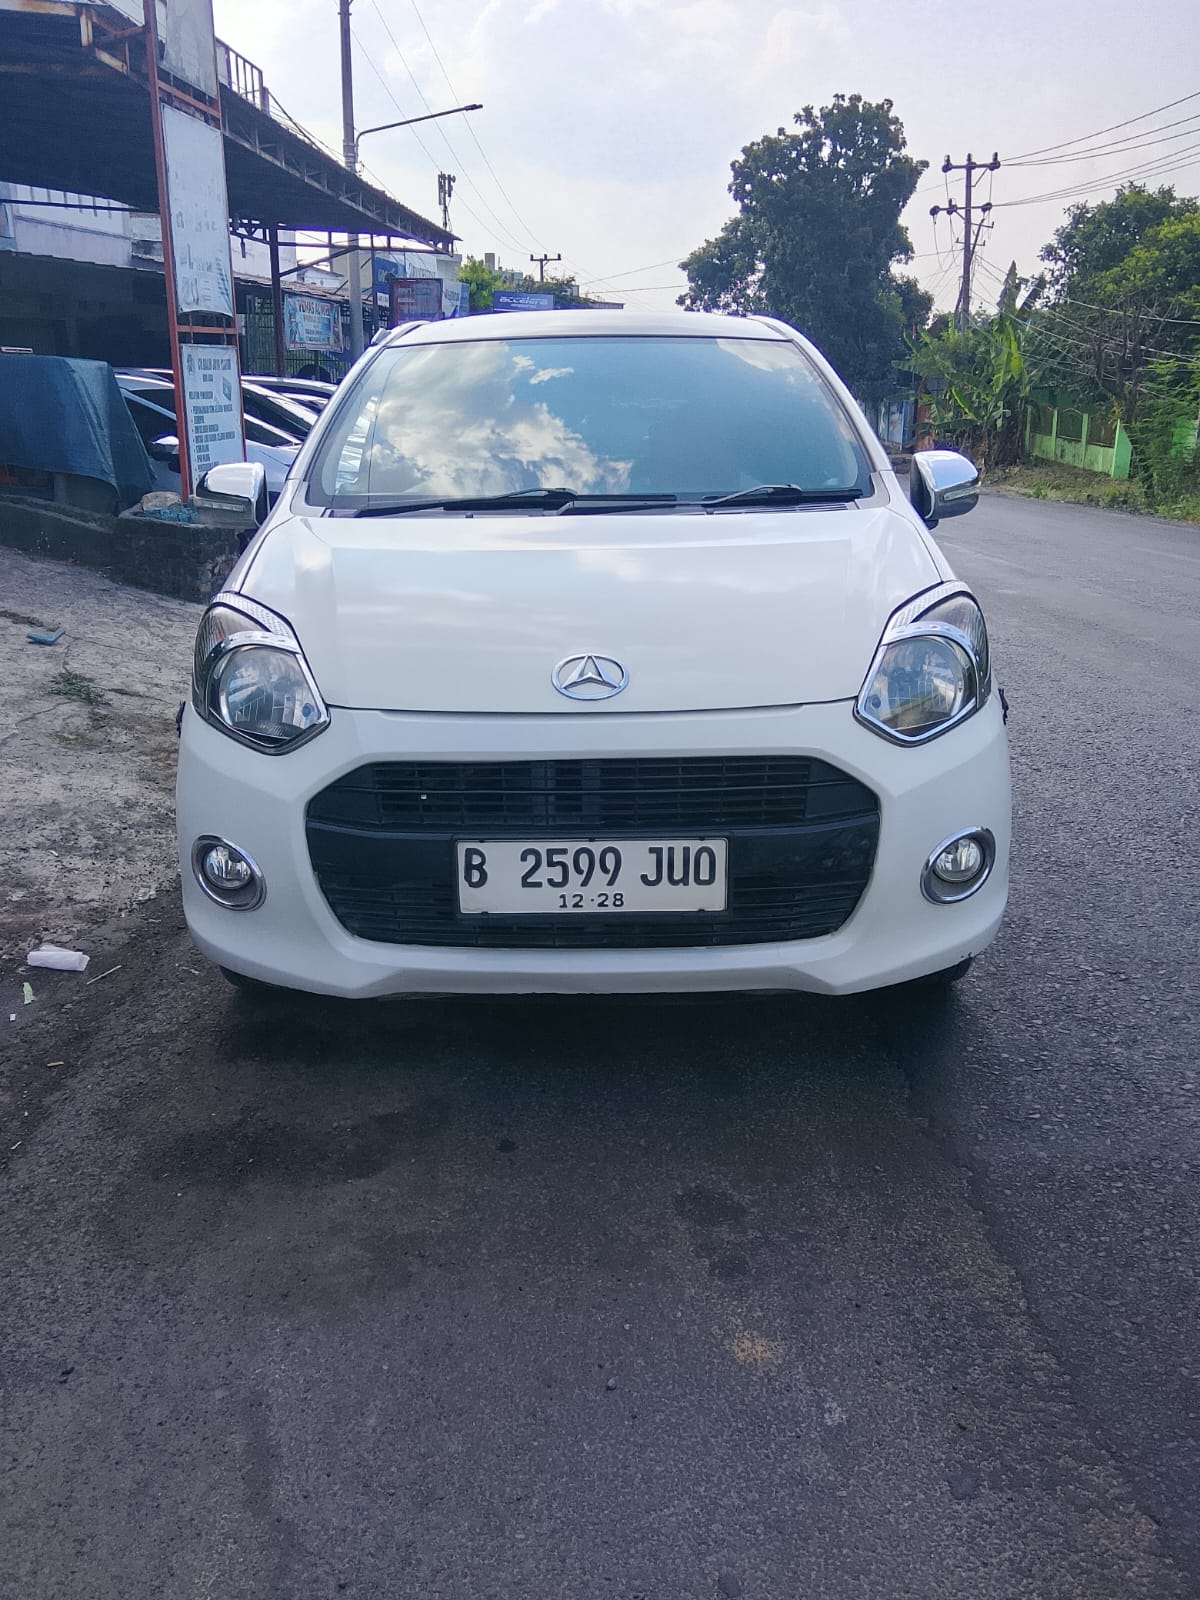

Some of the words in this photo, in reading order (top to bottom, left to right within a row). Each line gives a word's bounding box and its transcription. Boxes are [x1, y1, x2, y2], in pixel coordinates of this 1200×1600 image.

[463, 847, 489, 889] B
[519, 846, 622, 889] 2599
[640, 845, 716, 887] JUO
